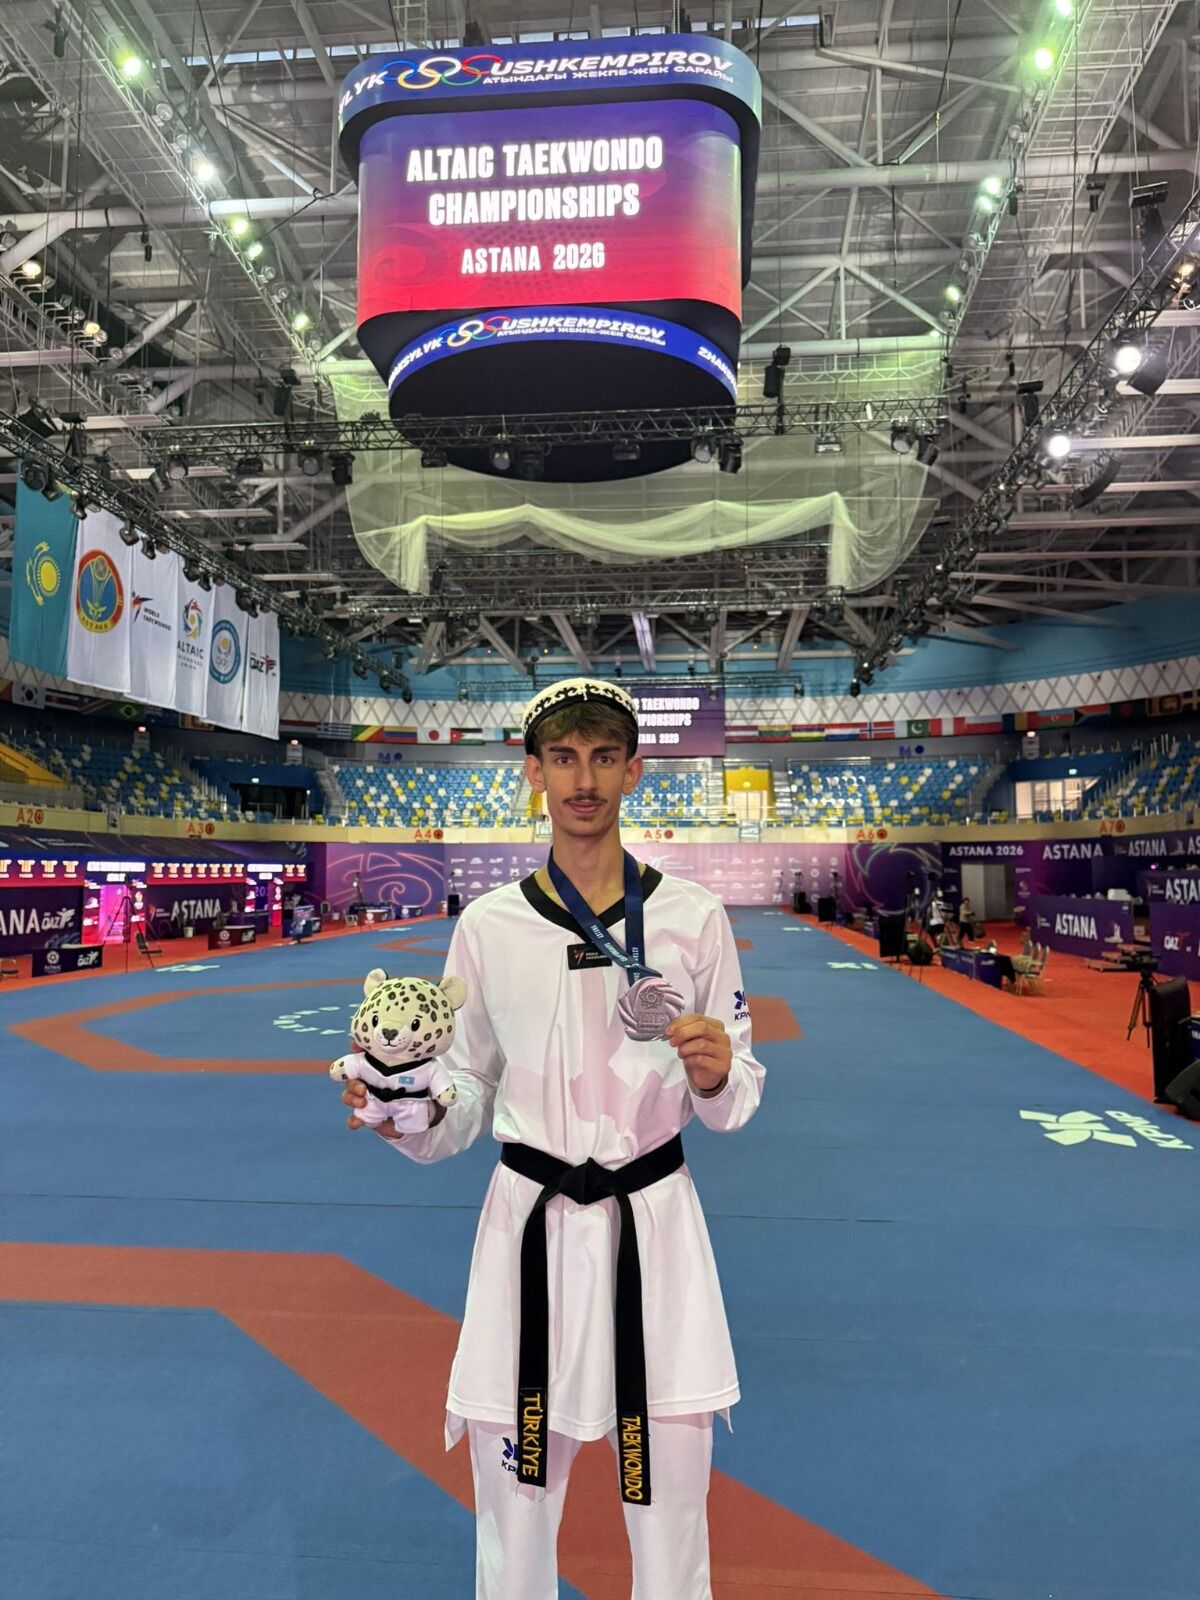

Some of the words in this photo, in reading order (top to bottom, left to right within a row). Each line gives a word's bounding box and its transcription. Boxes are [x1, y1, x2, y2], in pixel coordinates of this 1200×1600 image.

[491, 51, 732, 75] USHKEMPIROV
[407, 145, 494, 182] ALTAIC
[502, 136, 663, 177] TAEKWONDO
[428, 183, 640, 226] CHAMPIONSHIPS
[461, 245, 541, 274] ASTANA
[552, 242, 606, 271] 2026
[501, 317, 665, 338] USHKEMPIROV
[177, 640, 204, 660] ALTAIC
[638, 713, 692, 727] PIONSHIPS
[949, 846, 993, 857] ASTANA
[996, 845, 1024, 856] 2026
[1042, 844, 1103, 861] ASTANA
[1128, 838, 1168, 857] ASTANA
[1165, 878, 1200, 901] ASTA
[171, 898, 222, 922] ASTANA
[1055, 913, 1098, 941] ASTANA
[734, 1011, 751, 1021] KPN
[522, 1392, 543, 1477] TÜRKİYE
[501, 1459, 518, 1475] KP
[622, 1415, 643, 1501] TAEKWONDO
